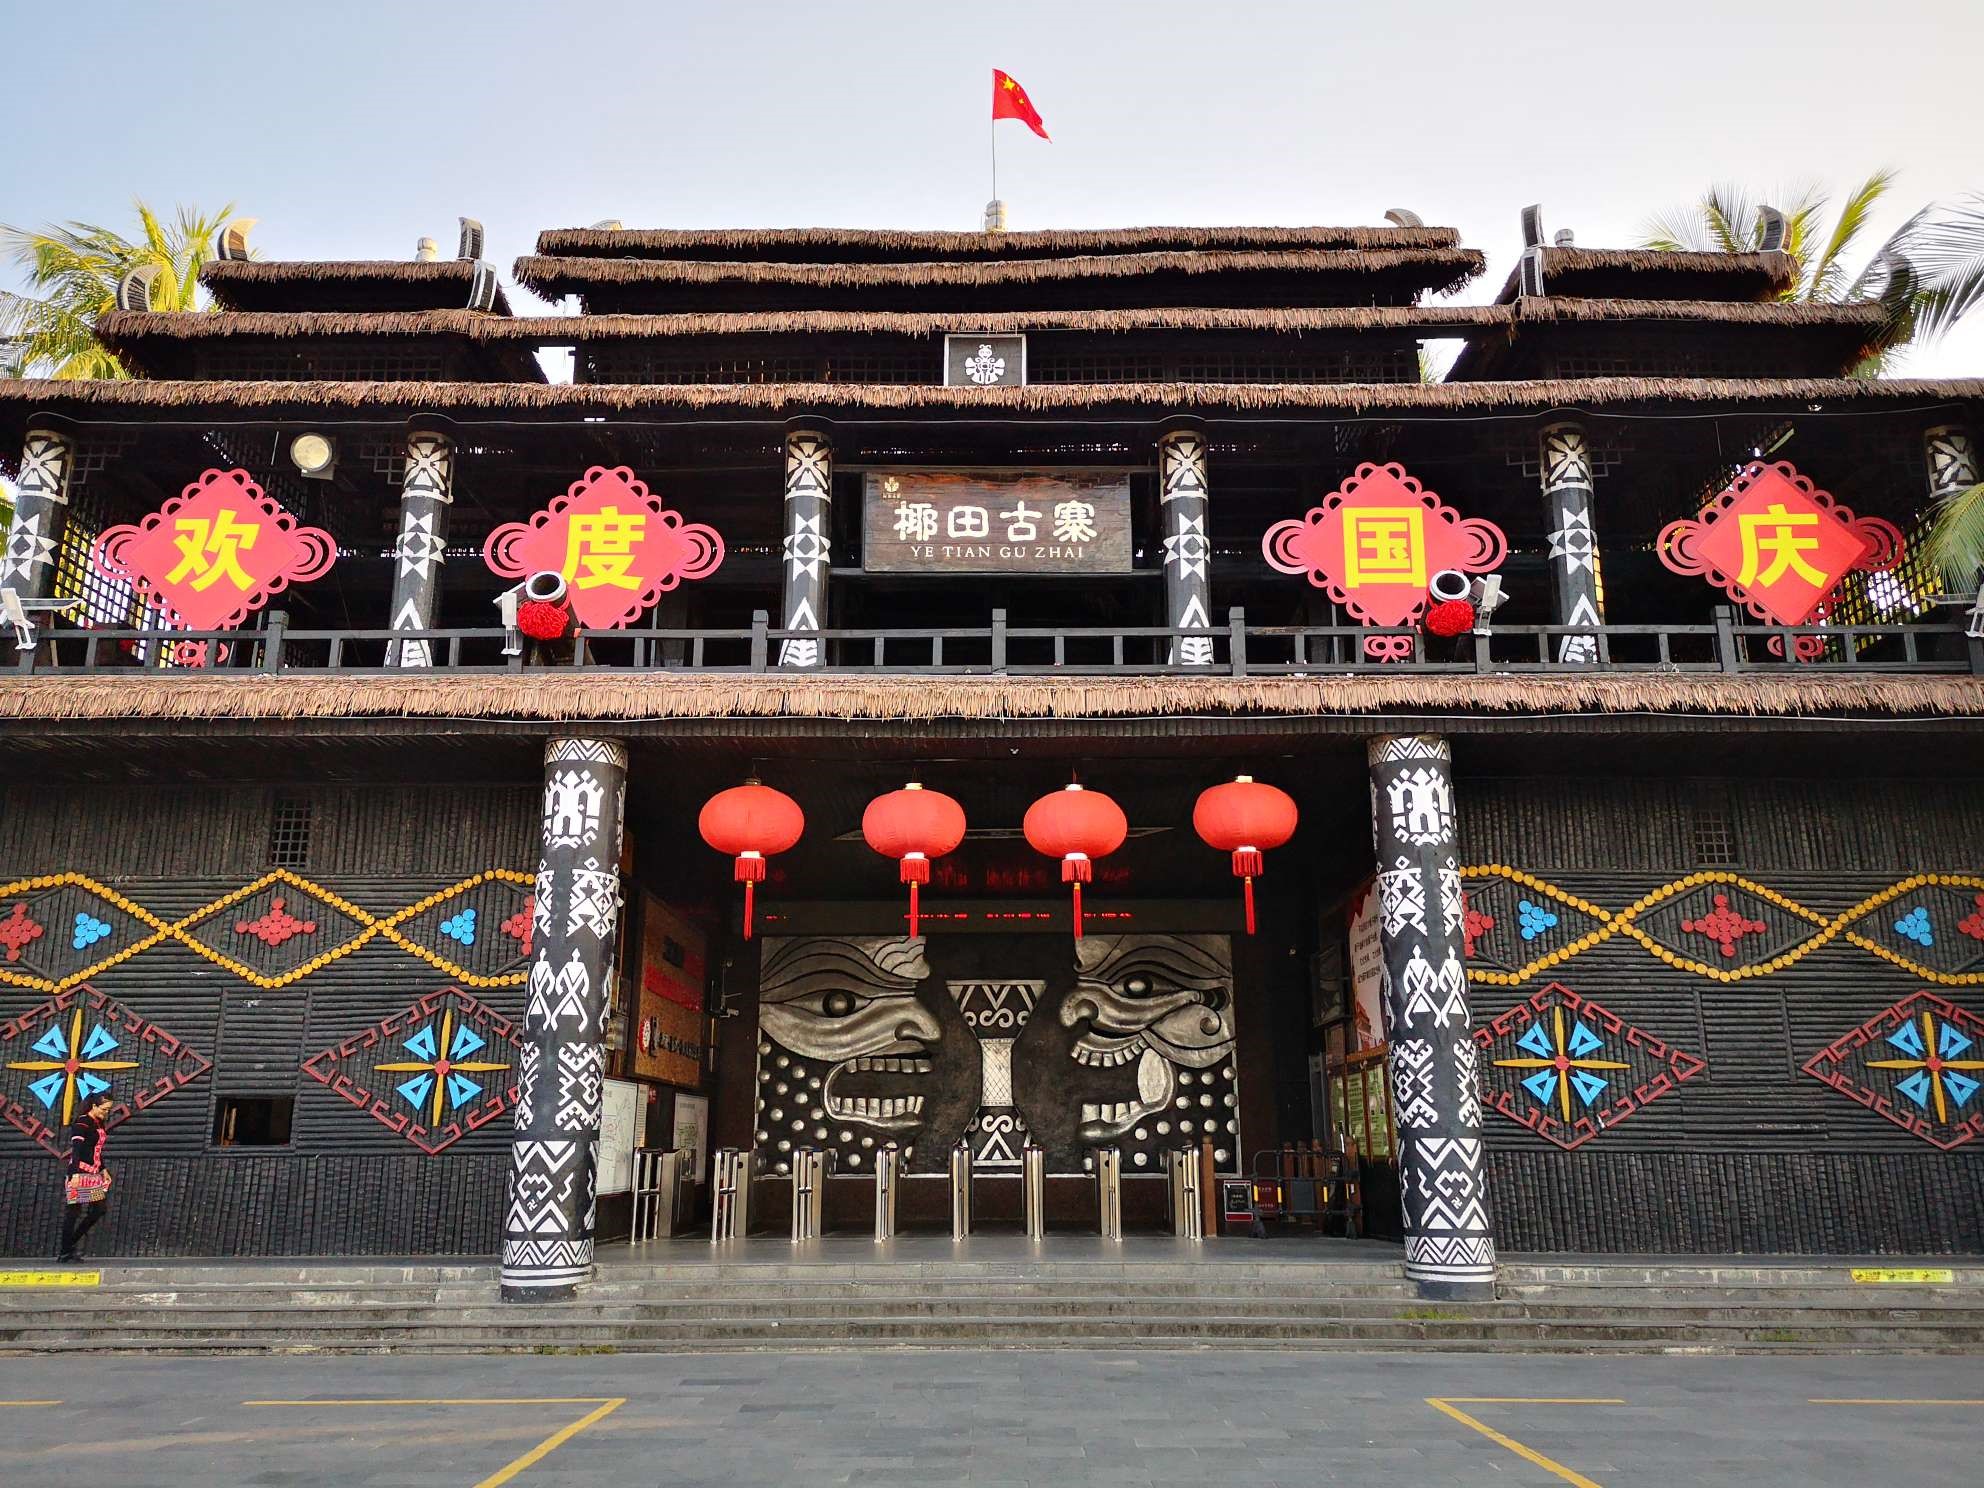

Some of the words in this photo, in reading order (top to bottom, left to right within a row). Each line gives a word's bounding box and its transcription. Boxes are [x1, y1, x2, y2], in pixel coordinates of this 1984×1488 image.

[165, 509, 259, 592] 欢
[562, 506, 646, 591] 度
[893, 500, 1097, 542] 椰田古寨
[911, 546, 934, 558] YE
[942, 546, 991, 558] TIAN
[999, 546, 1026, 558] GU
[1034, 546, 1084, 558] ZHAI
[1342, 506, 1427, 589] 国
[1737, 504, 1828, 588] 庆
